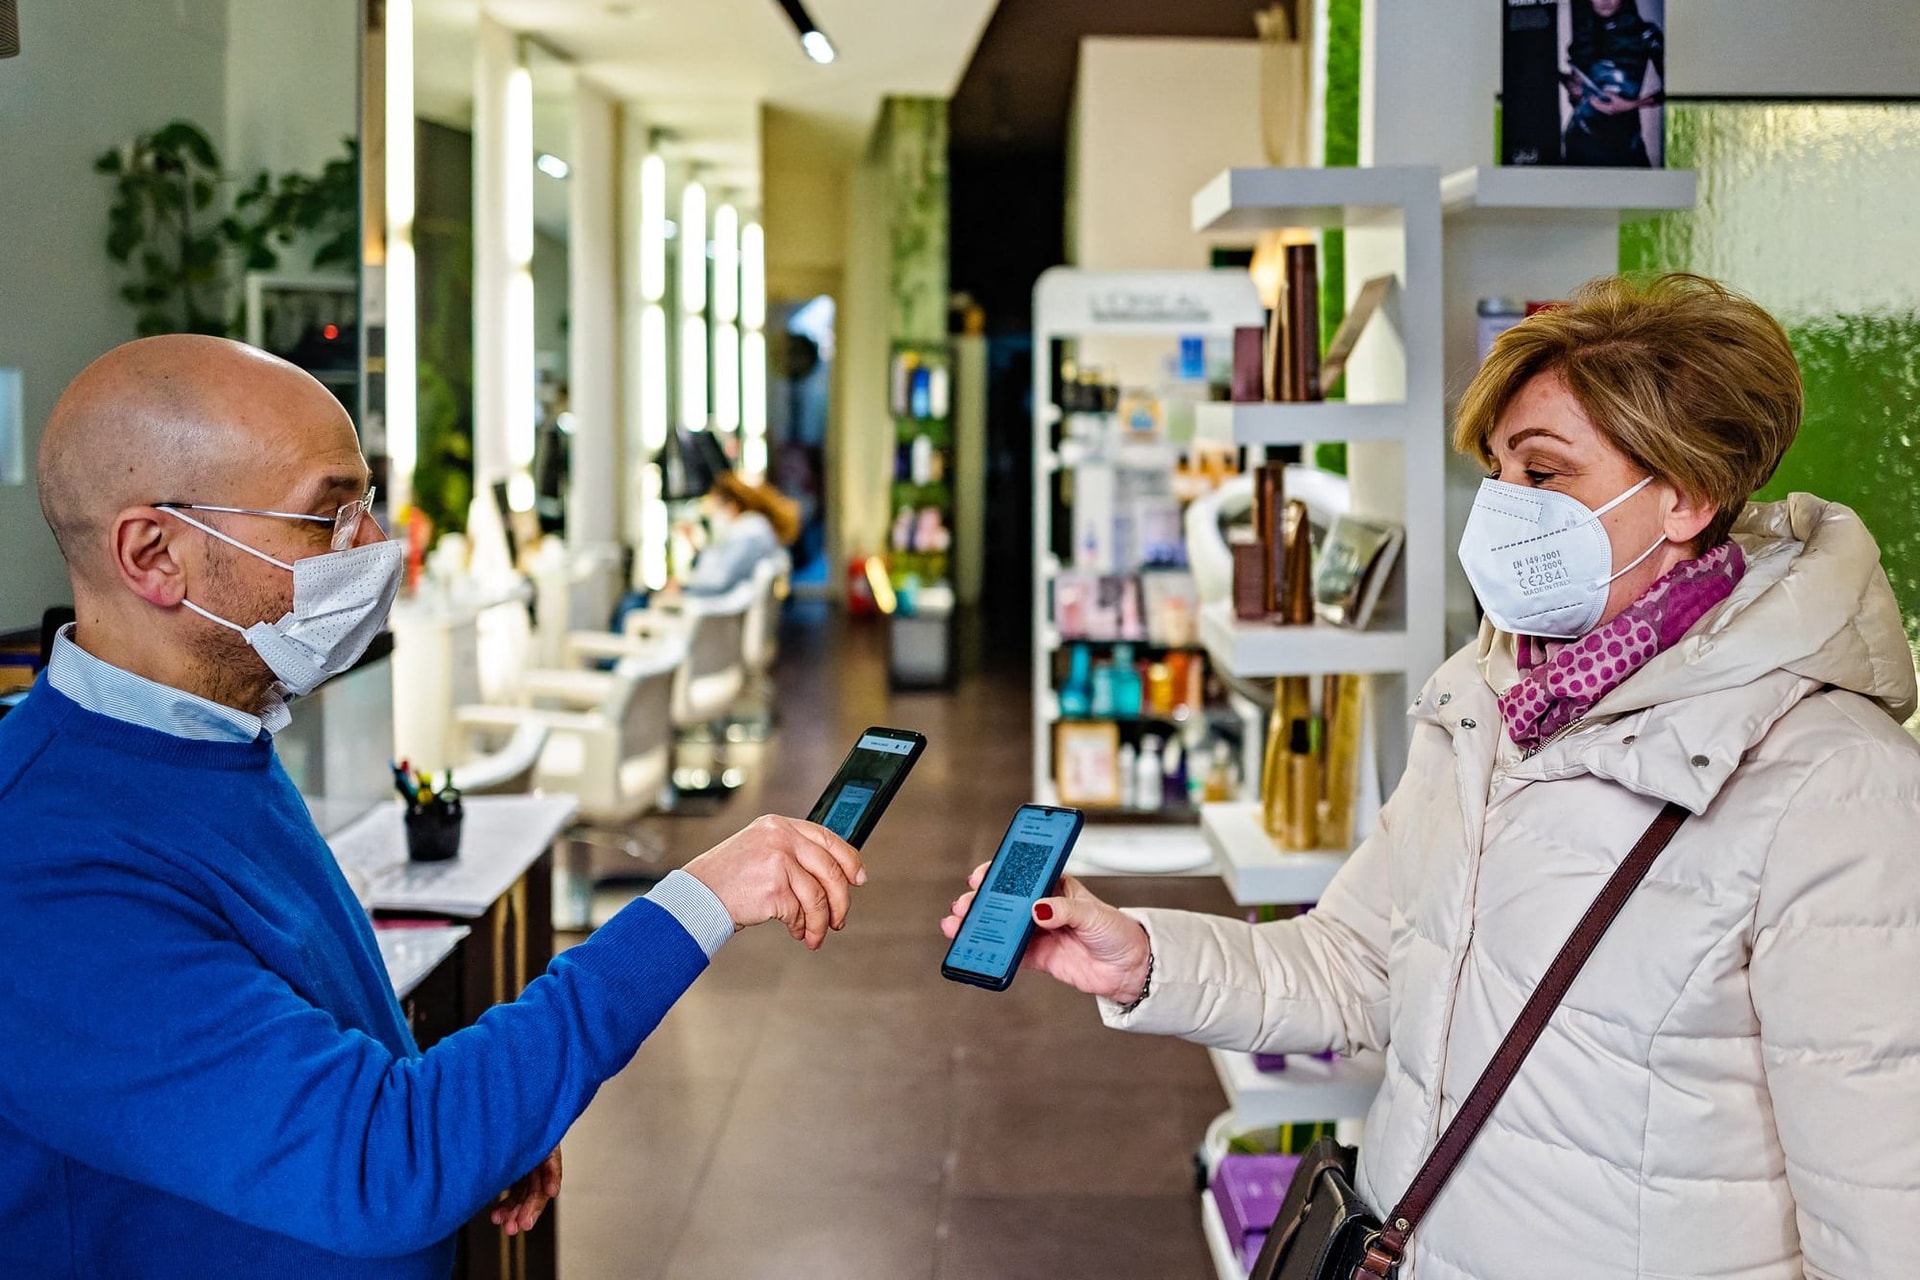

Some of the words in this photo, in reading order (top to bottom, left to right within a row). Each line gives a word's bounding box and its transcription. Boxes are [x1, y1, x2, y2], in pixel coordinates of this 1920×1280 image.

[1512, 559, 1522, 569] EN
[1525, 549, 1561, 565] 149:2001
[1530, 559, 1562, 574] A1:2009
[1523, 586, 1544, 596] MADE
[1553, 579, 1571, 588] ITALY
